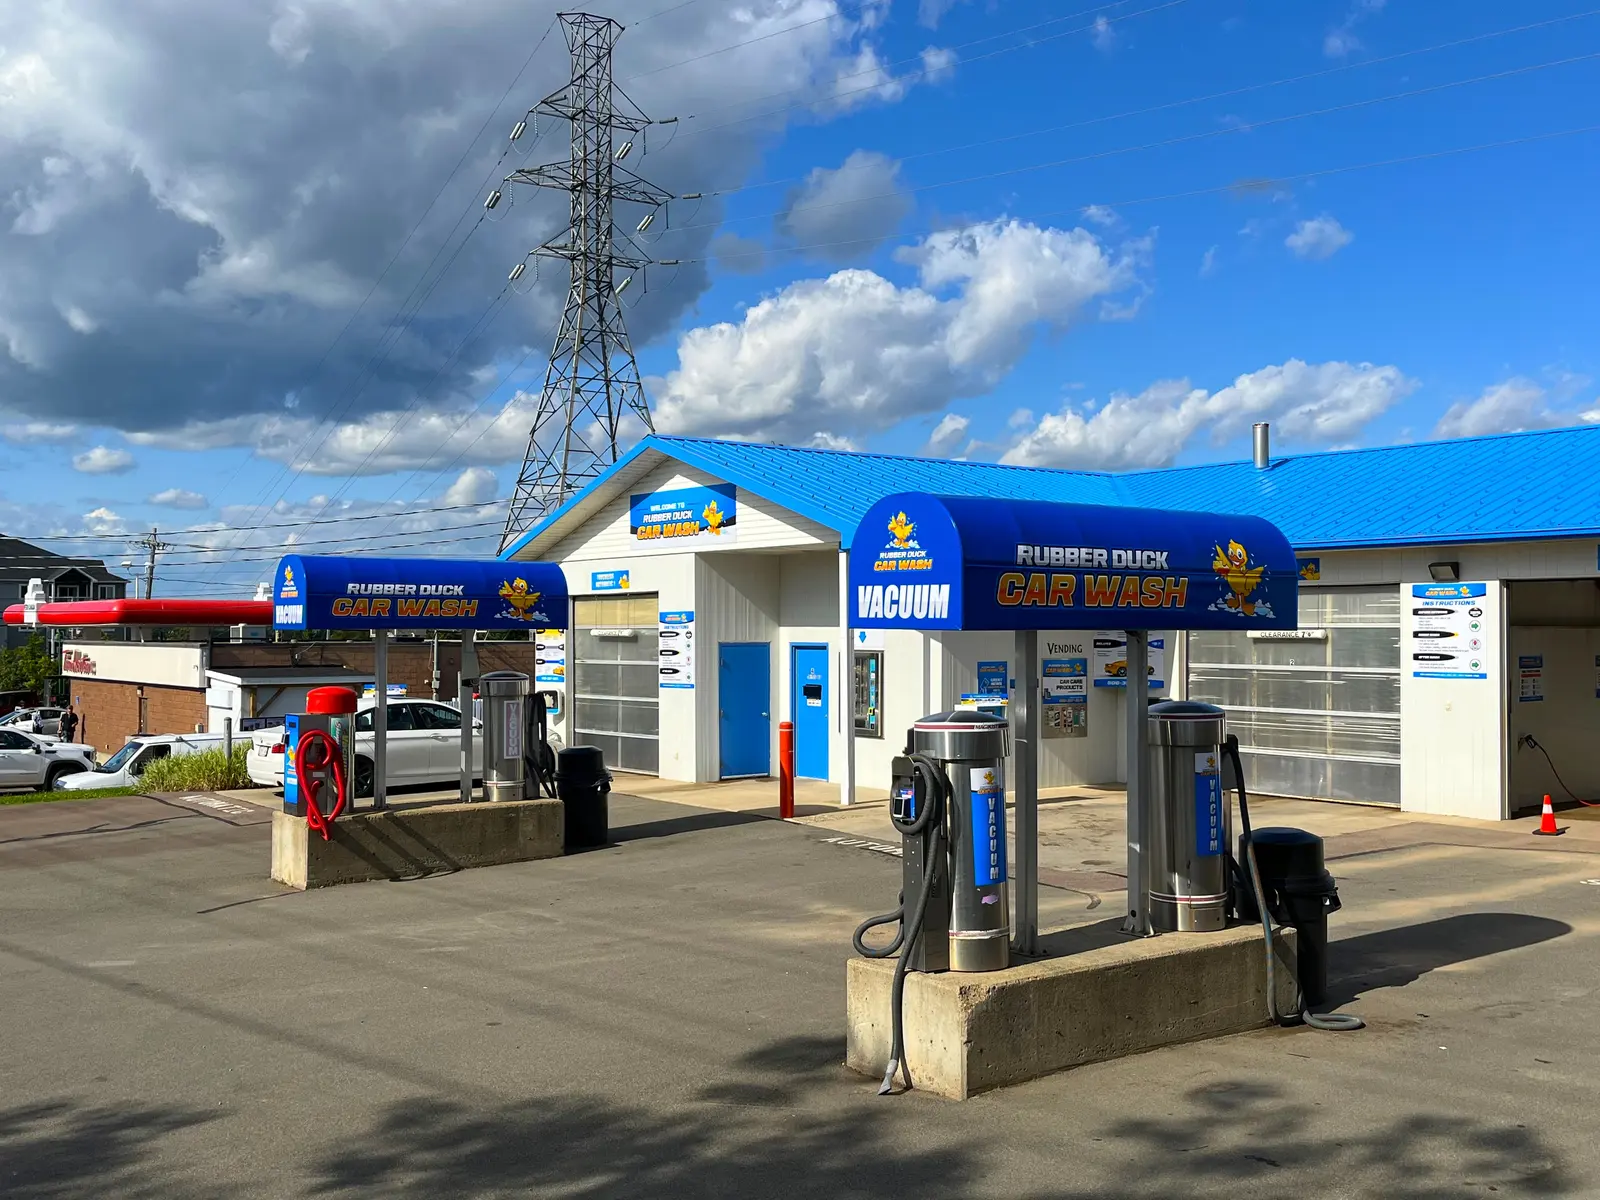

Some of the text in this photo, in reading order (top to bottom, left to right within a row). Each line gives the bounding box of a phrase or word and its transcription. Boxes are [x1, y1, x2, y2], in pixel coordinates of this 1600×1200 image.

[643, 510, 693, 523] RUBBER DUCK
[650, 503, 677, 512] WELCOME
[637, 521, 700, 540] CAR WASH
[880, 550, 927, 559] RUBBER DUCK
[1016, 544, 1169, 570] RUBBER DUCK
[874, 558, 933, 571] CAR WASH
[346, 583, 464, 596] RUBBER DUCK
[997, 572, 1189, 608] CAR WASH
[332, 598, 478, 617] CAR WASH
[858, 584, 950, 619] VACUUM
[509, 703, 518, 756] VACUUM
[1209, 779, 1218, 851] VACUUM
[987, 797, 999, 880] VACUUM
